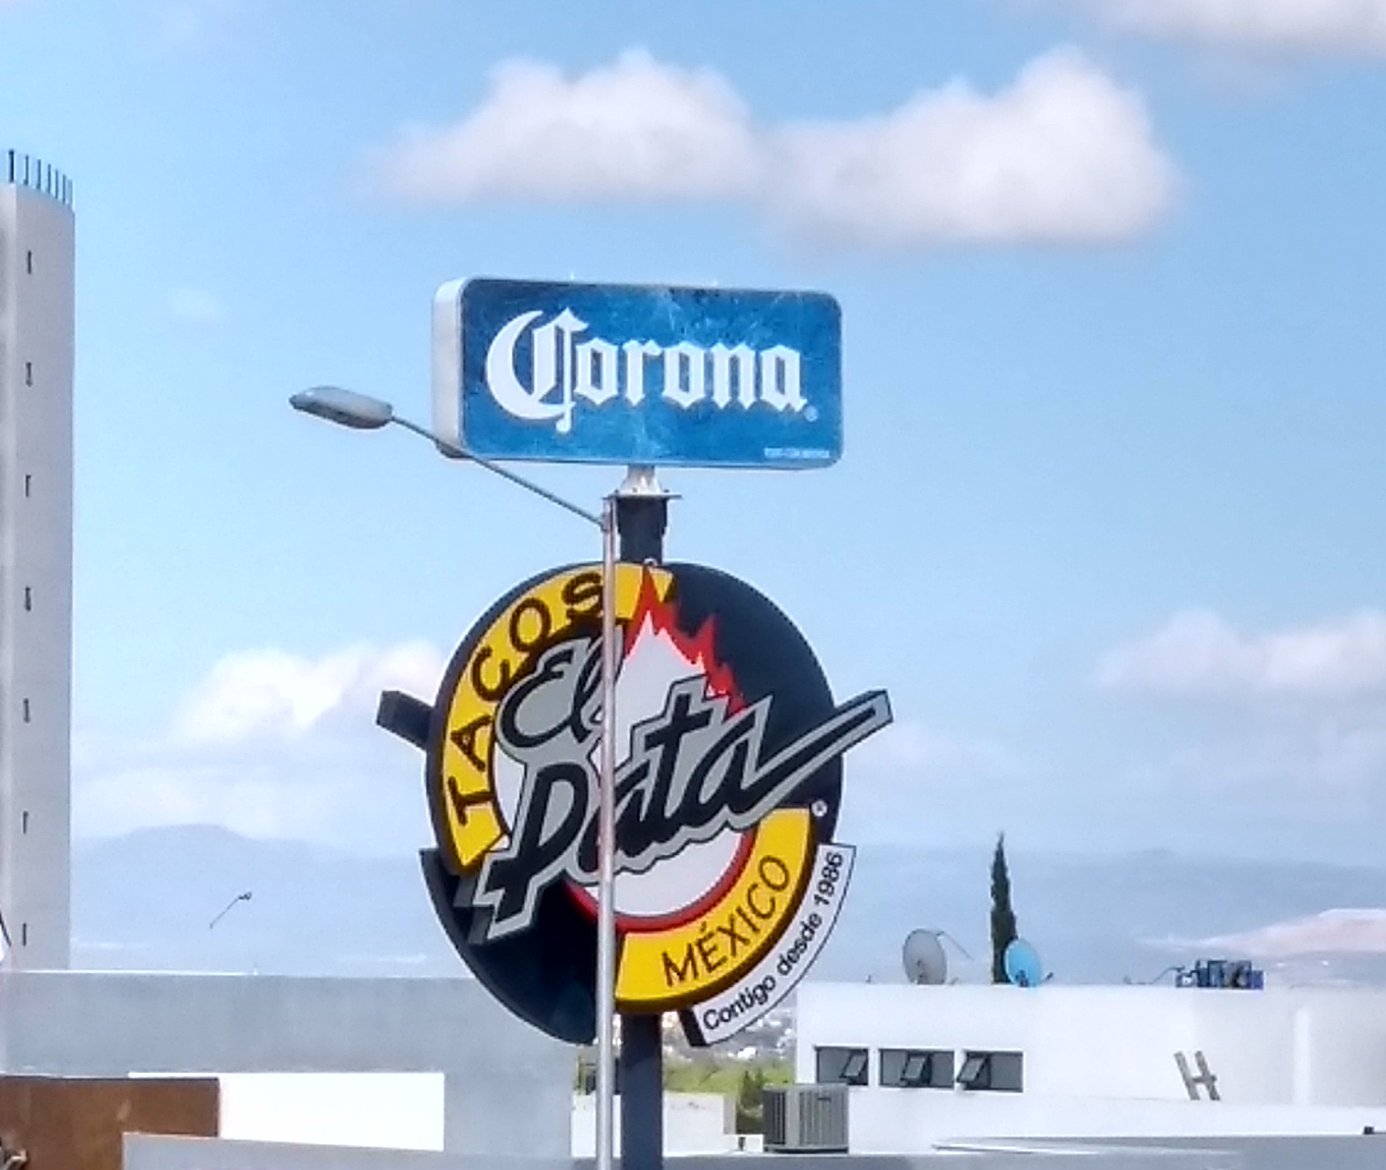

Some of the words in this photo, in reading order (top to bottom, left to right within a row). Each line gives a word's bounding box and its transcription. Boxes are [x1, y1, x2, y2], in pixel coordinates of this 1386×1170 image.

[486, 307, 808, 433] Corona
[448, 572, 604, 826] TACOS
[498, 622, 613, 746] El
[482, 683, 881, 926] Pata
[662, 855, 790, 988] MÉXICO
[702, 975, 776, 1031] Contigo
[776, 912, 822, 977] desde
[813, 851, 844, 906] 1986
